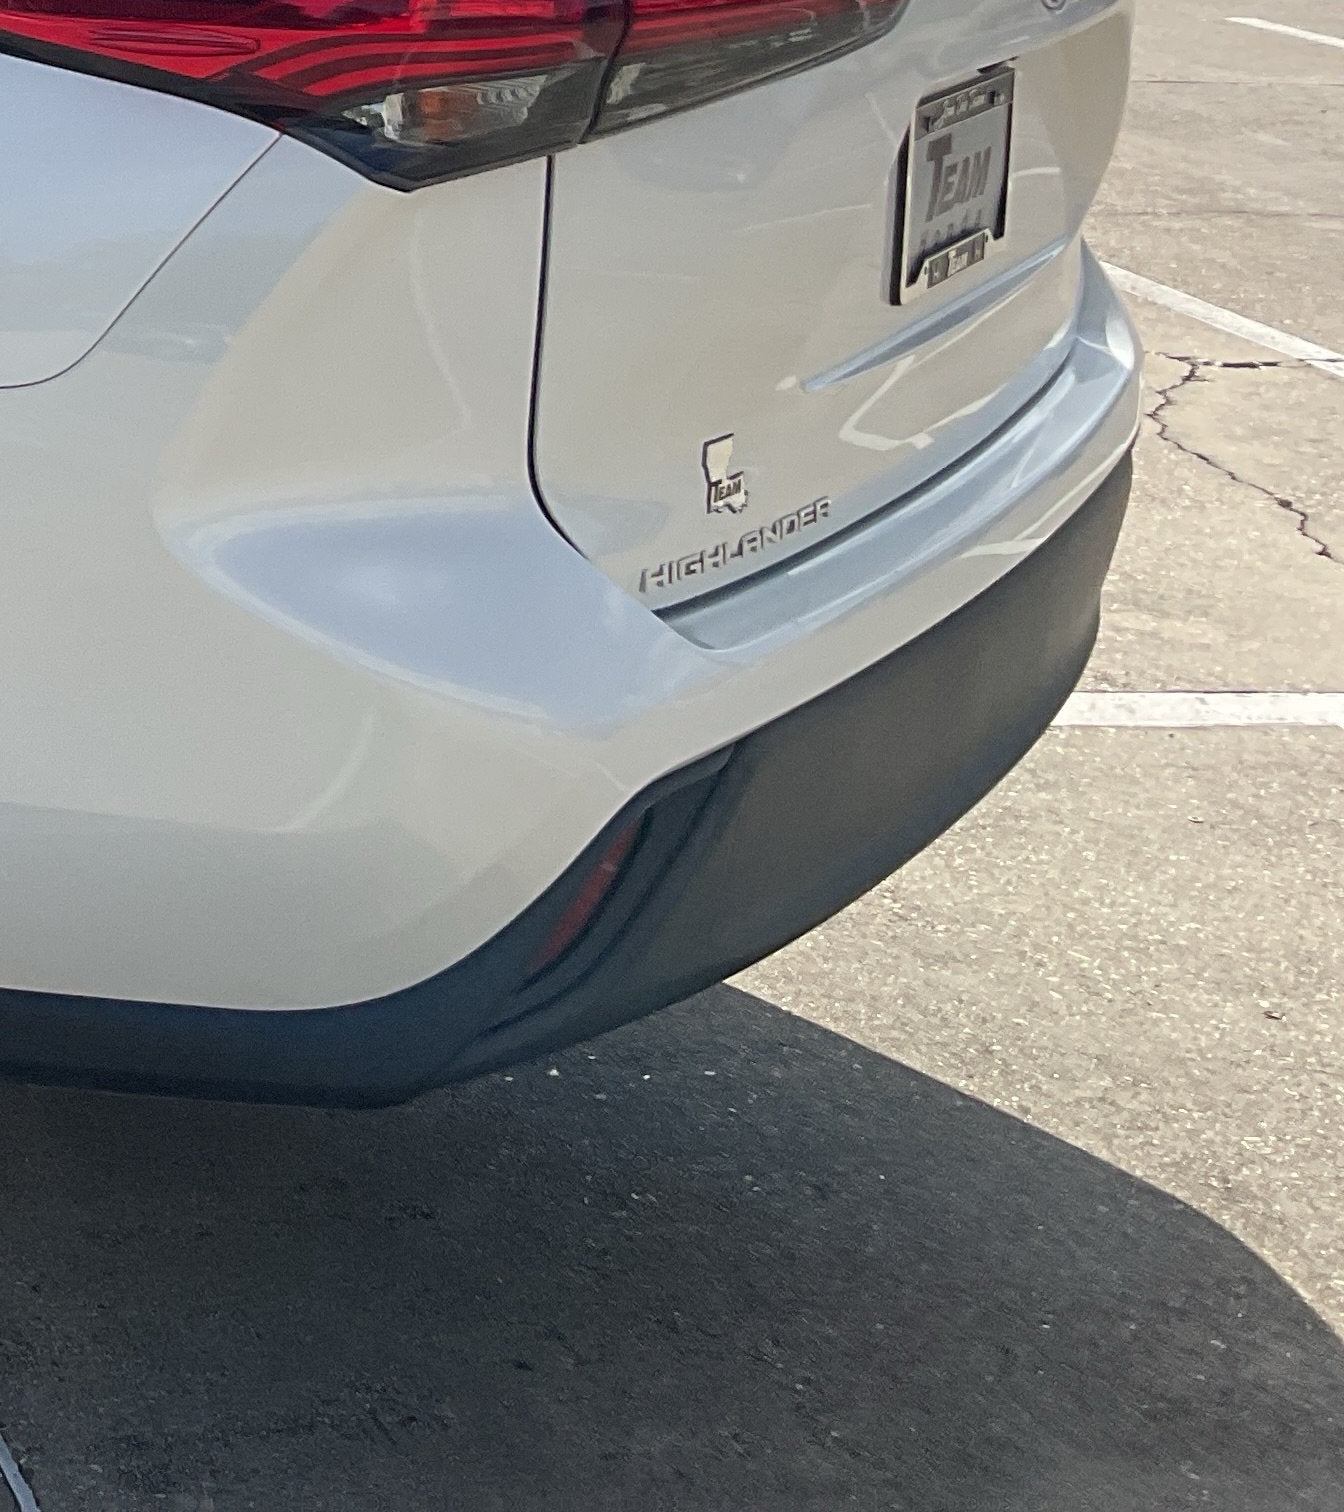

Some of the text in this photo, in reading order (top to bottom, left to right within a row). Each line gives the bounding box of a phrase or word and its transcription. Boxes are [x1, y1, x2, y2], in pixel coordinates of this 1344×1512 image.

[926, 134, 991, 222] TEAM
[713, 479, 742, 502] TEAM
[638, 496, 832, 593] HIGHLANDER
